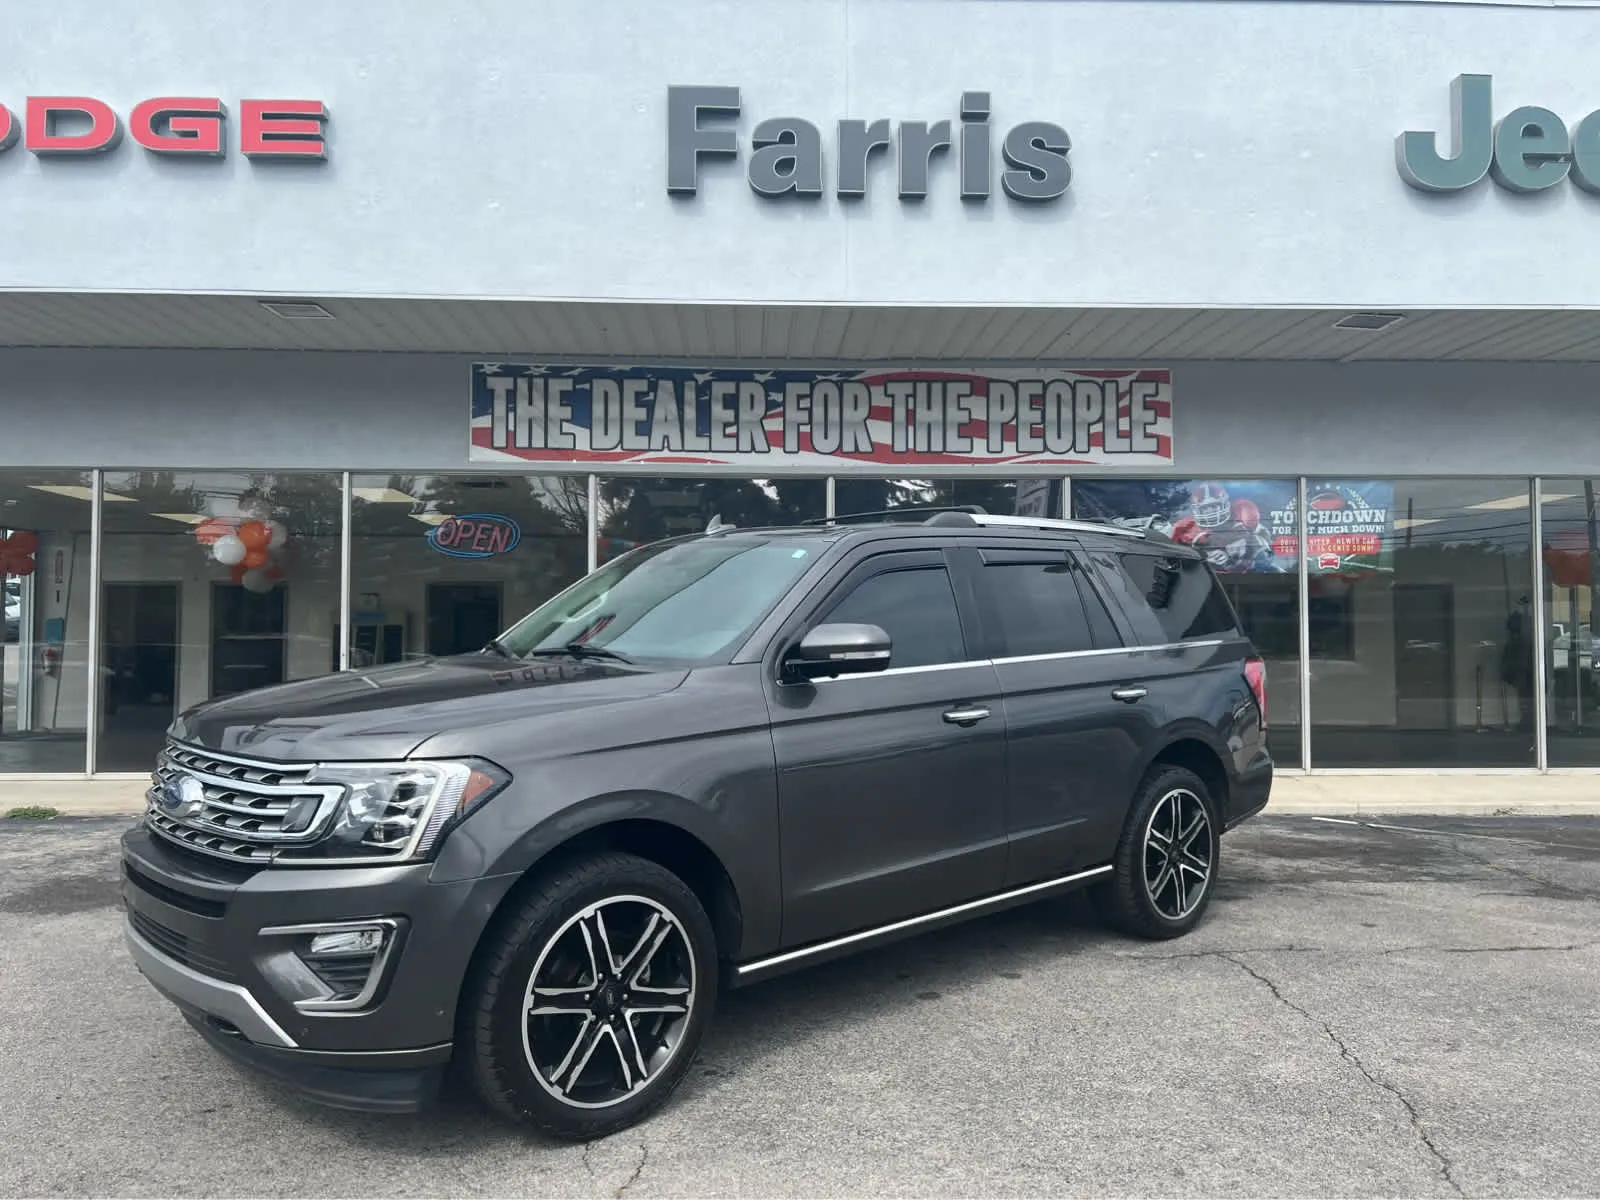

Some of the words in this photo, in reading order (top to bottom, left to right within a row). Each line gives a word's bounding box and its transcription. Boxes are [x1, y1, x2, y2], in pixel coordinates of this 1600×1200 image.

[0, 94, 328, 161] DGE
[667, 85, 1073, 202] Farris
[486, 375, 577, 451] THE
[590, 377, 772, 454] DEALER
[783, 378, 874, 455] FOR
[883, 380, 974, 454] THE
[986, 379, 1160, 455] PEOPLE
[437, 519, 511, 552] OPEN
[1270, 510, 1386, 524] TOCHDOWN
[1272, 526, 1291, 534] FOR
[1317, 525, 1349, 534] MUCH
